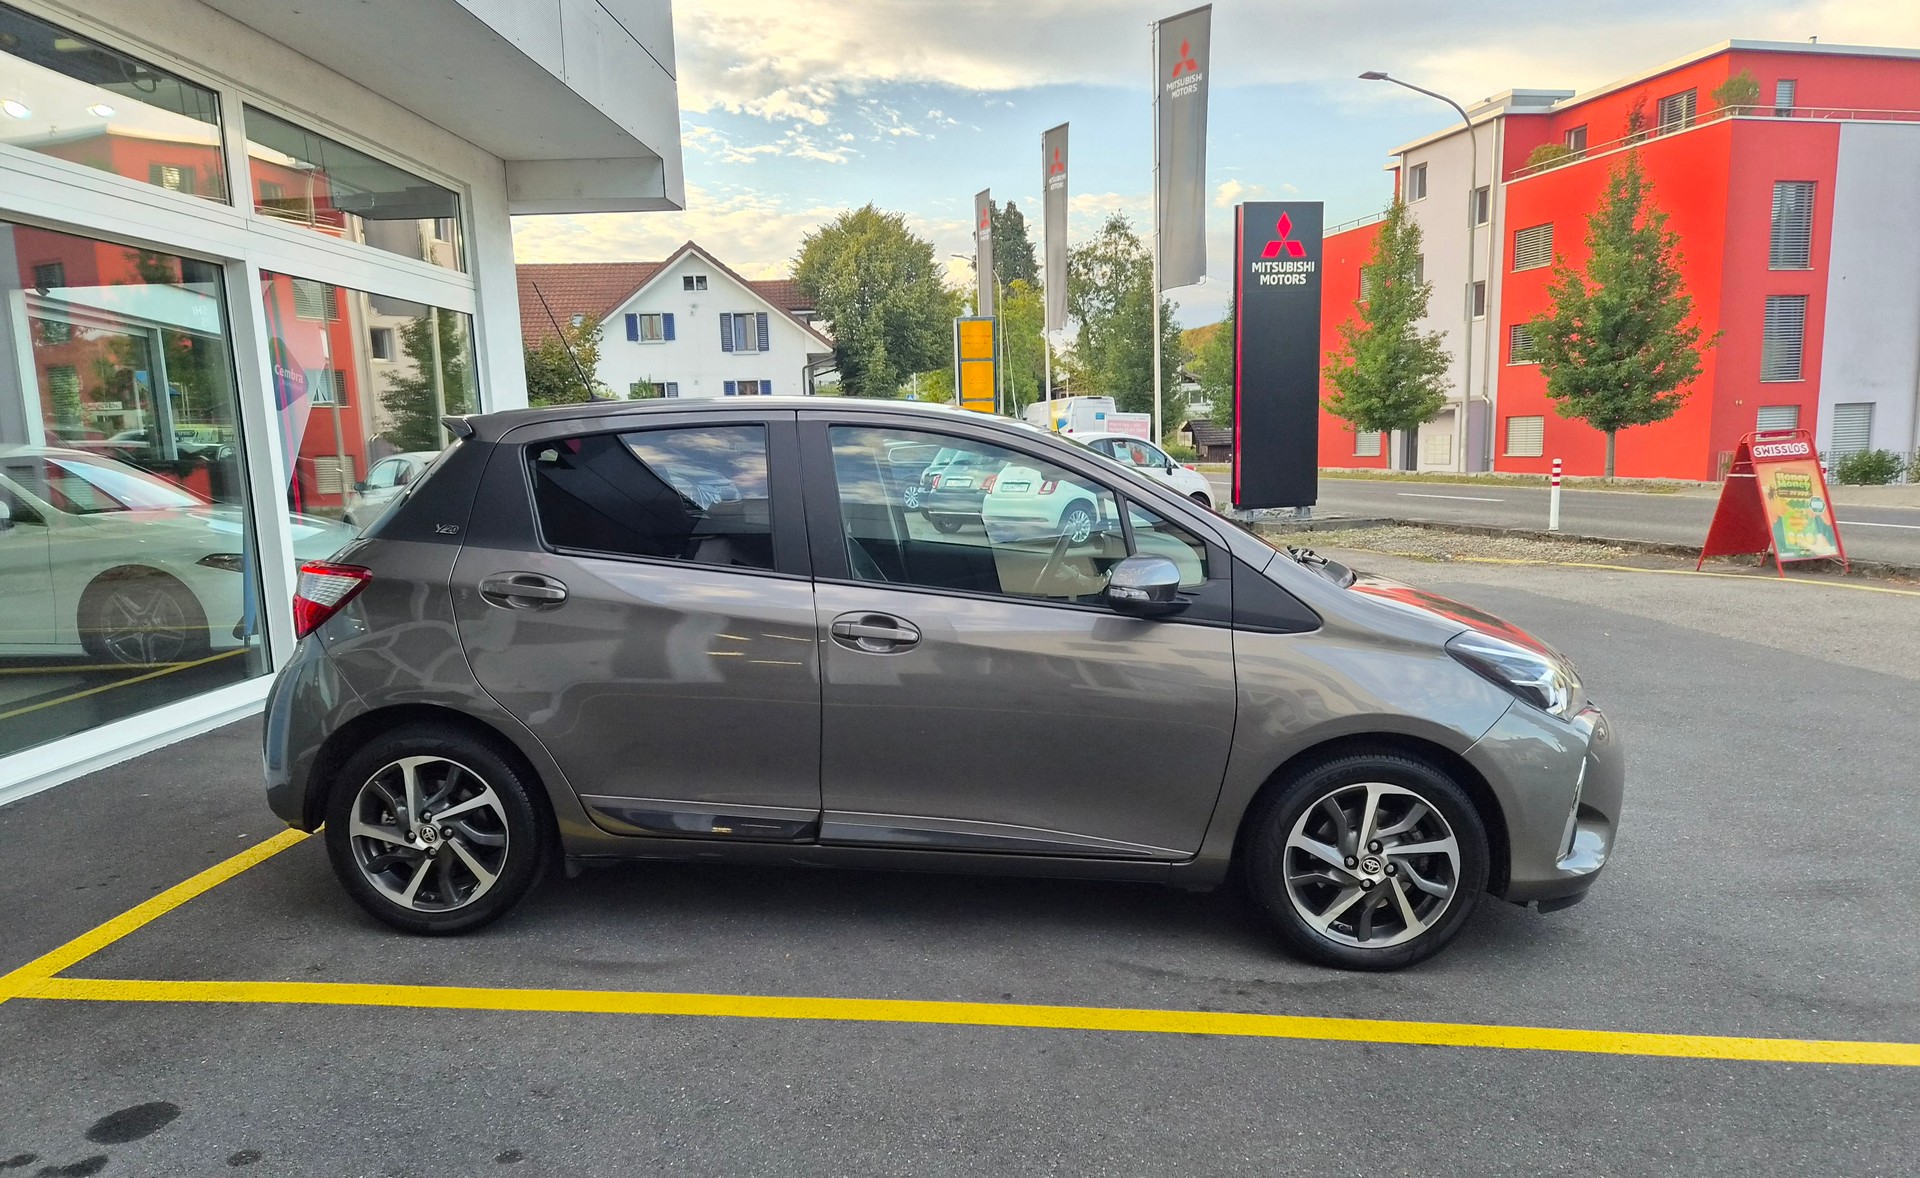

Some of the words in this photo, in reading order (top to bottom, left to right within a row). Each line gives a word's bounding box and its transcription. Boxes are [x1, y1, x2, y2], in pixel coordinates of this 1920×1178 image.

[1166, 72, 1203, 91] MITSUBISHI
[1171, 83, 1198, 99] MOTORS
[1251, 261, 1315, 273] MITSUBISHI
[1260, 273, 1307, 285] MOTORS
[274, 364, 304, 384] Cembra
[1754, 444, 1808, 456] SWISSLOS
